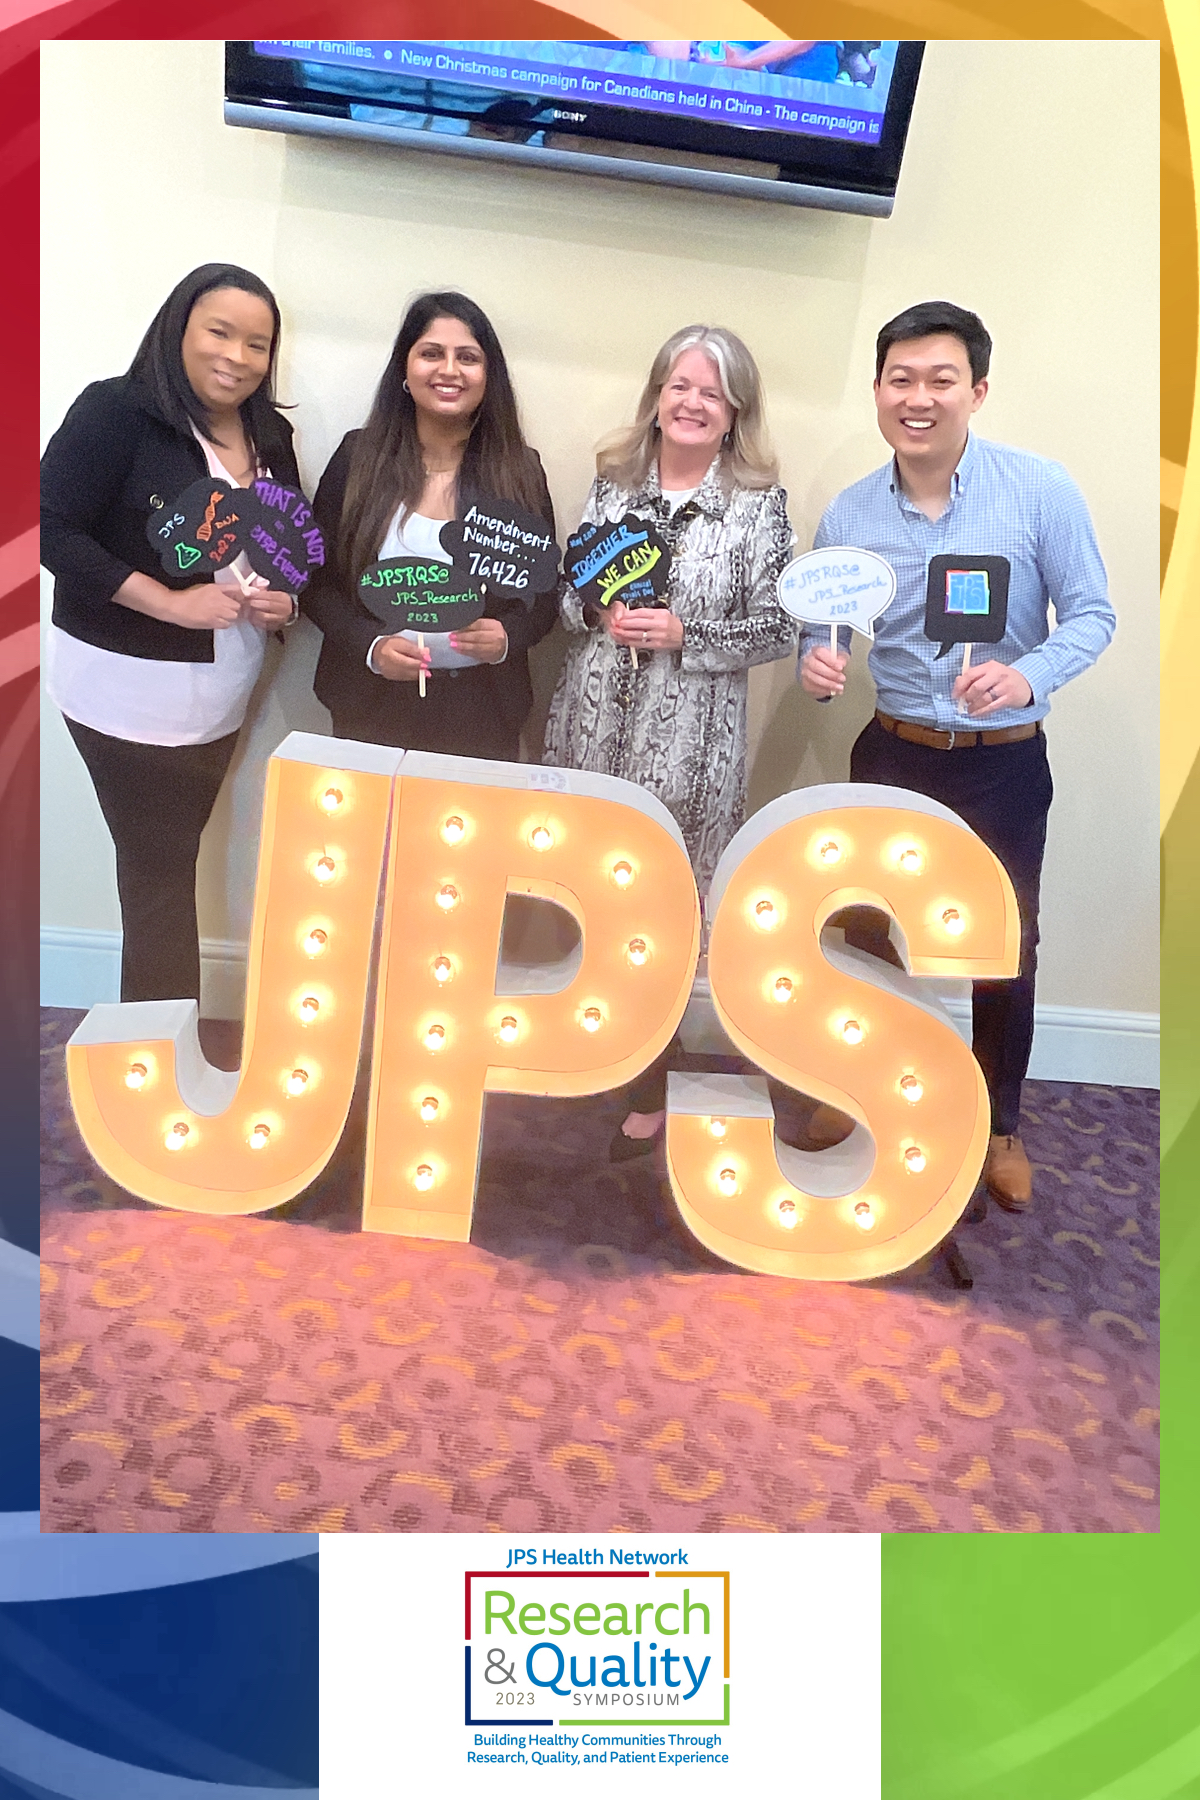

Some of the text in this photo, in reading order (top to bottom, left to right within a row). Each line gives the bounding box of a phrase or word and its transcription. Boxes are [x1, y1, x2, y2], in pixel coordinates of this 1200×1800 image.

[318, 41, 376, 60] families.
[401, 49, 433, 68] New
[435, 54, 508, 79] Christmas
[511, 68, 578, 91] campaign
[580, 75, 601, 92] for
[604, 79, 676, 104] Canadians
[678, 90, 707, 108] held
[710, 94, 722, 110] in
[725, 97, 763, 116] China
[774, 104, 798, 123] The
[801, 111, 866, 133] campaign
[868, 118, 880, 135] is
[553, 109, 588, 122] SONY
[158, 512, 186, 539] JPS
[250, 523, 278, 555] erse
[254, 481, 326, 566] THAT IS NOT
[463, 505, 552, 551] Amendment
[208, 532, 237, 562] 2023
[571, 524, 633, 578] TOGETHER
[596, 540, 654, 590] WE CAN
[406, 612, 439, 624] 2023
[829, 600, 858, 616] 2023
[66, 732, 1021, 1280] JPS
